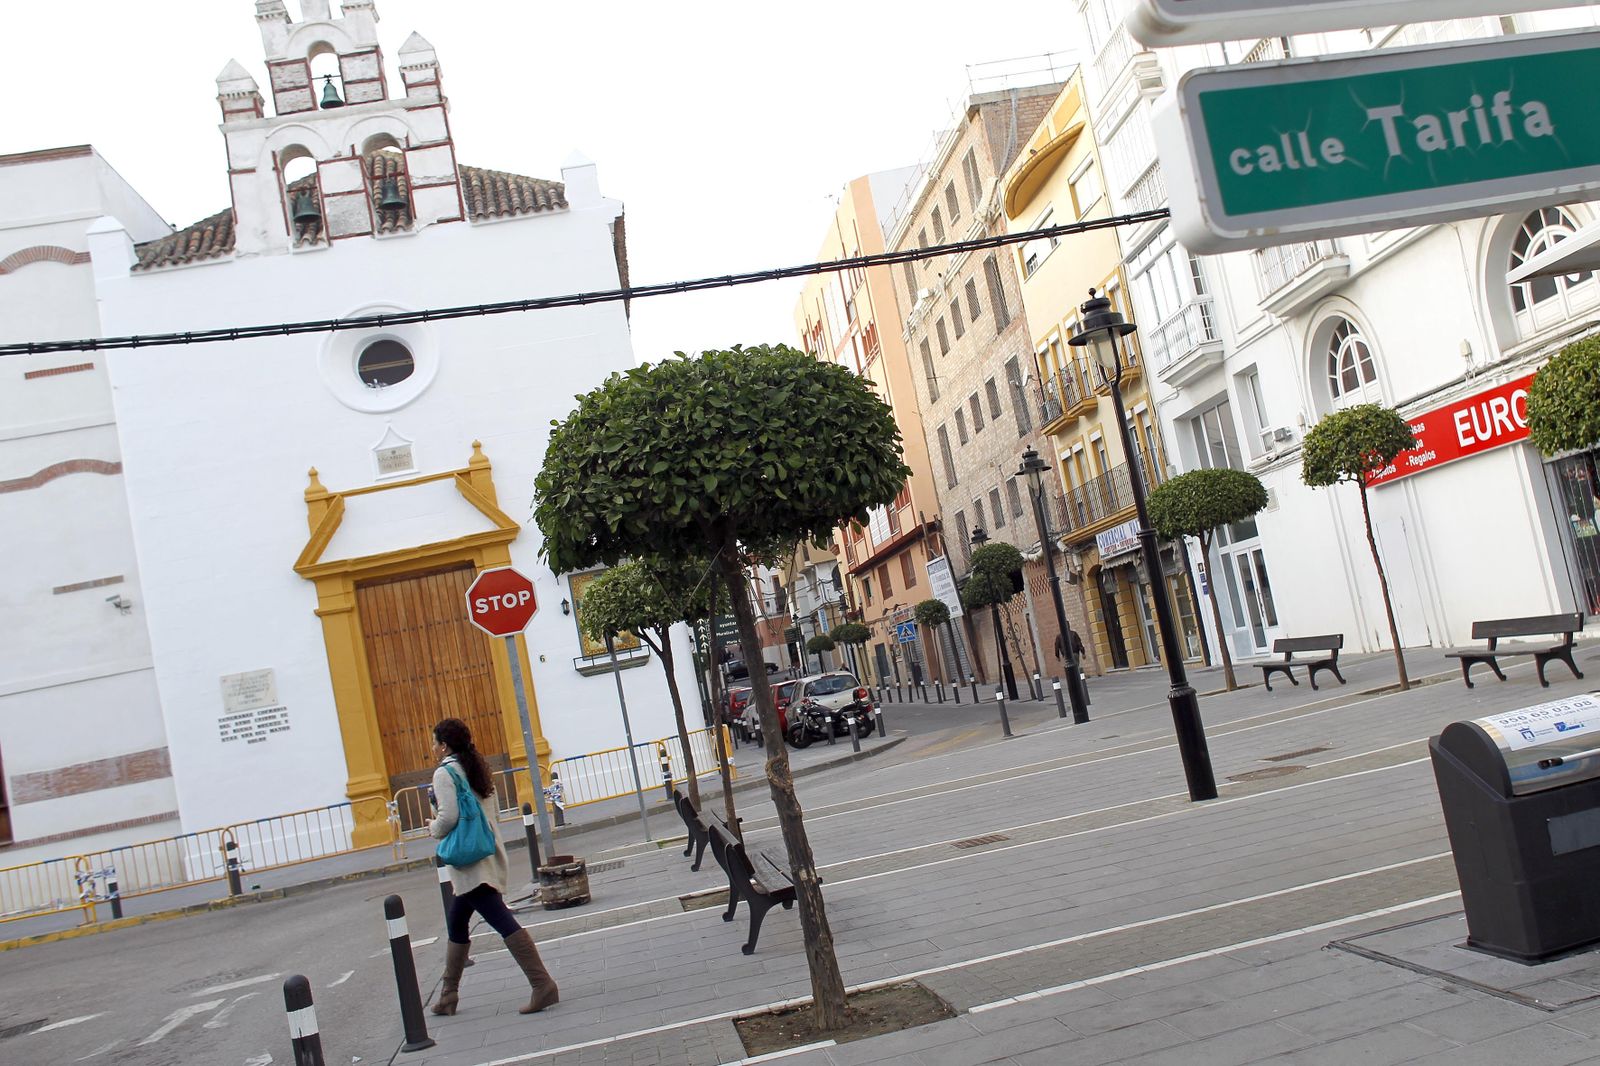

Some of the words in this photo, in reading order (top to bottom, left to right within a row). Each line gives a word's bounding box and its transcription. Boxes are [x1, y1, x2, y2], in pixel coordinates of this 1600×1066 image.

[1229, 130, 1345, 176] calle
[1367, 91, 1554, 157] Tarifa
[1408, 450, 1437, 467] Regalos
[475, 589, 531, 614] STOP
[539, 654, 546, 663] 6
